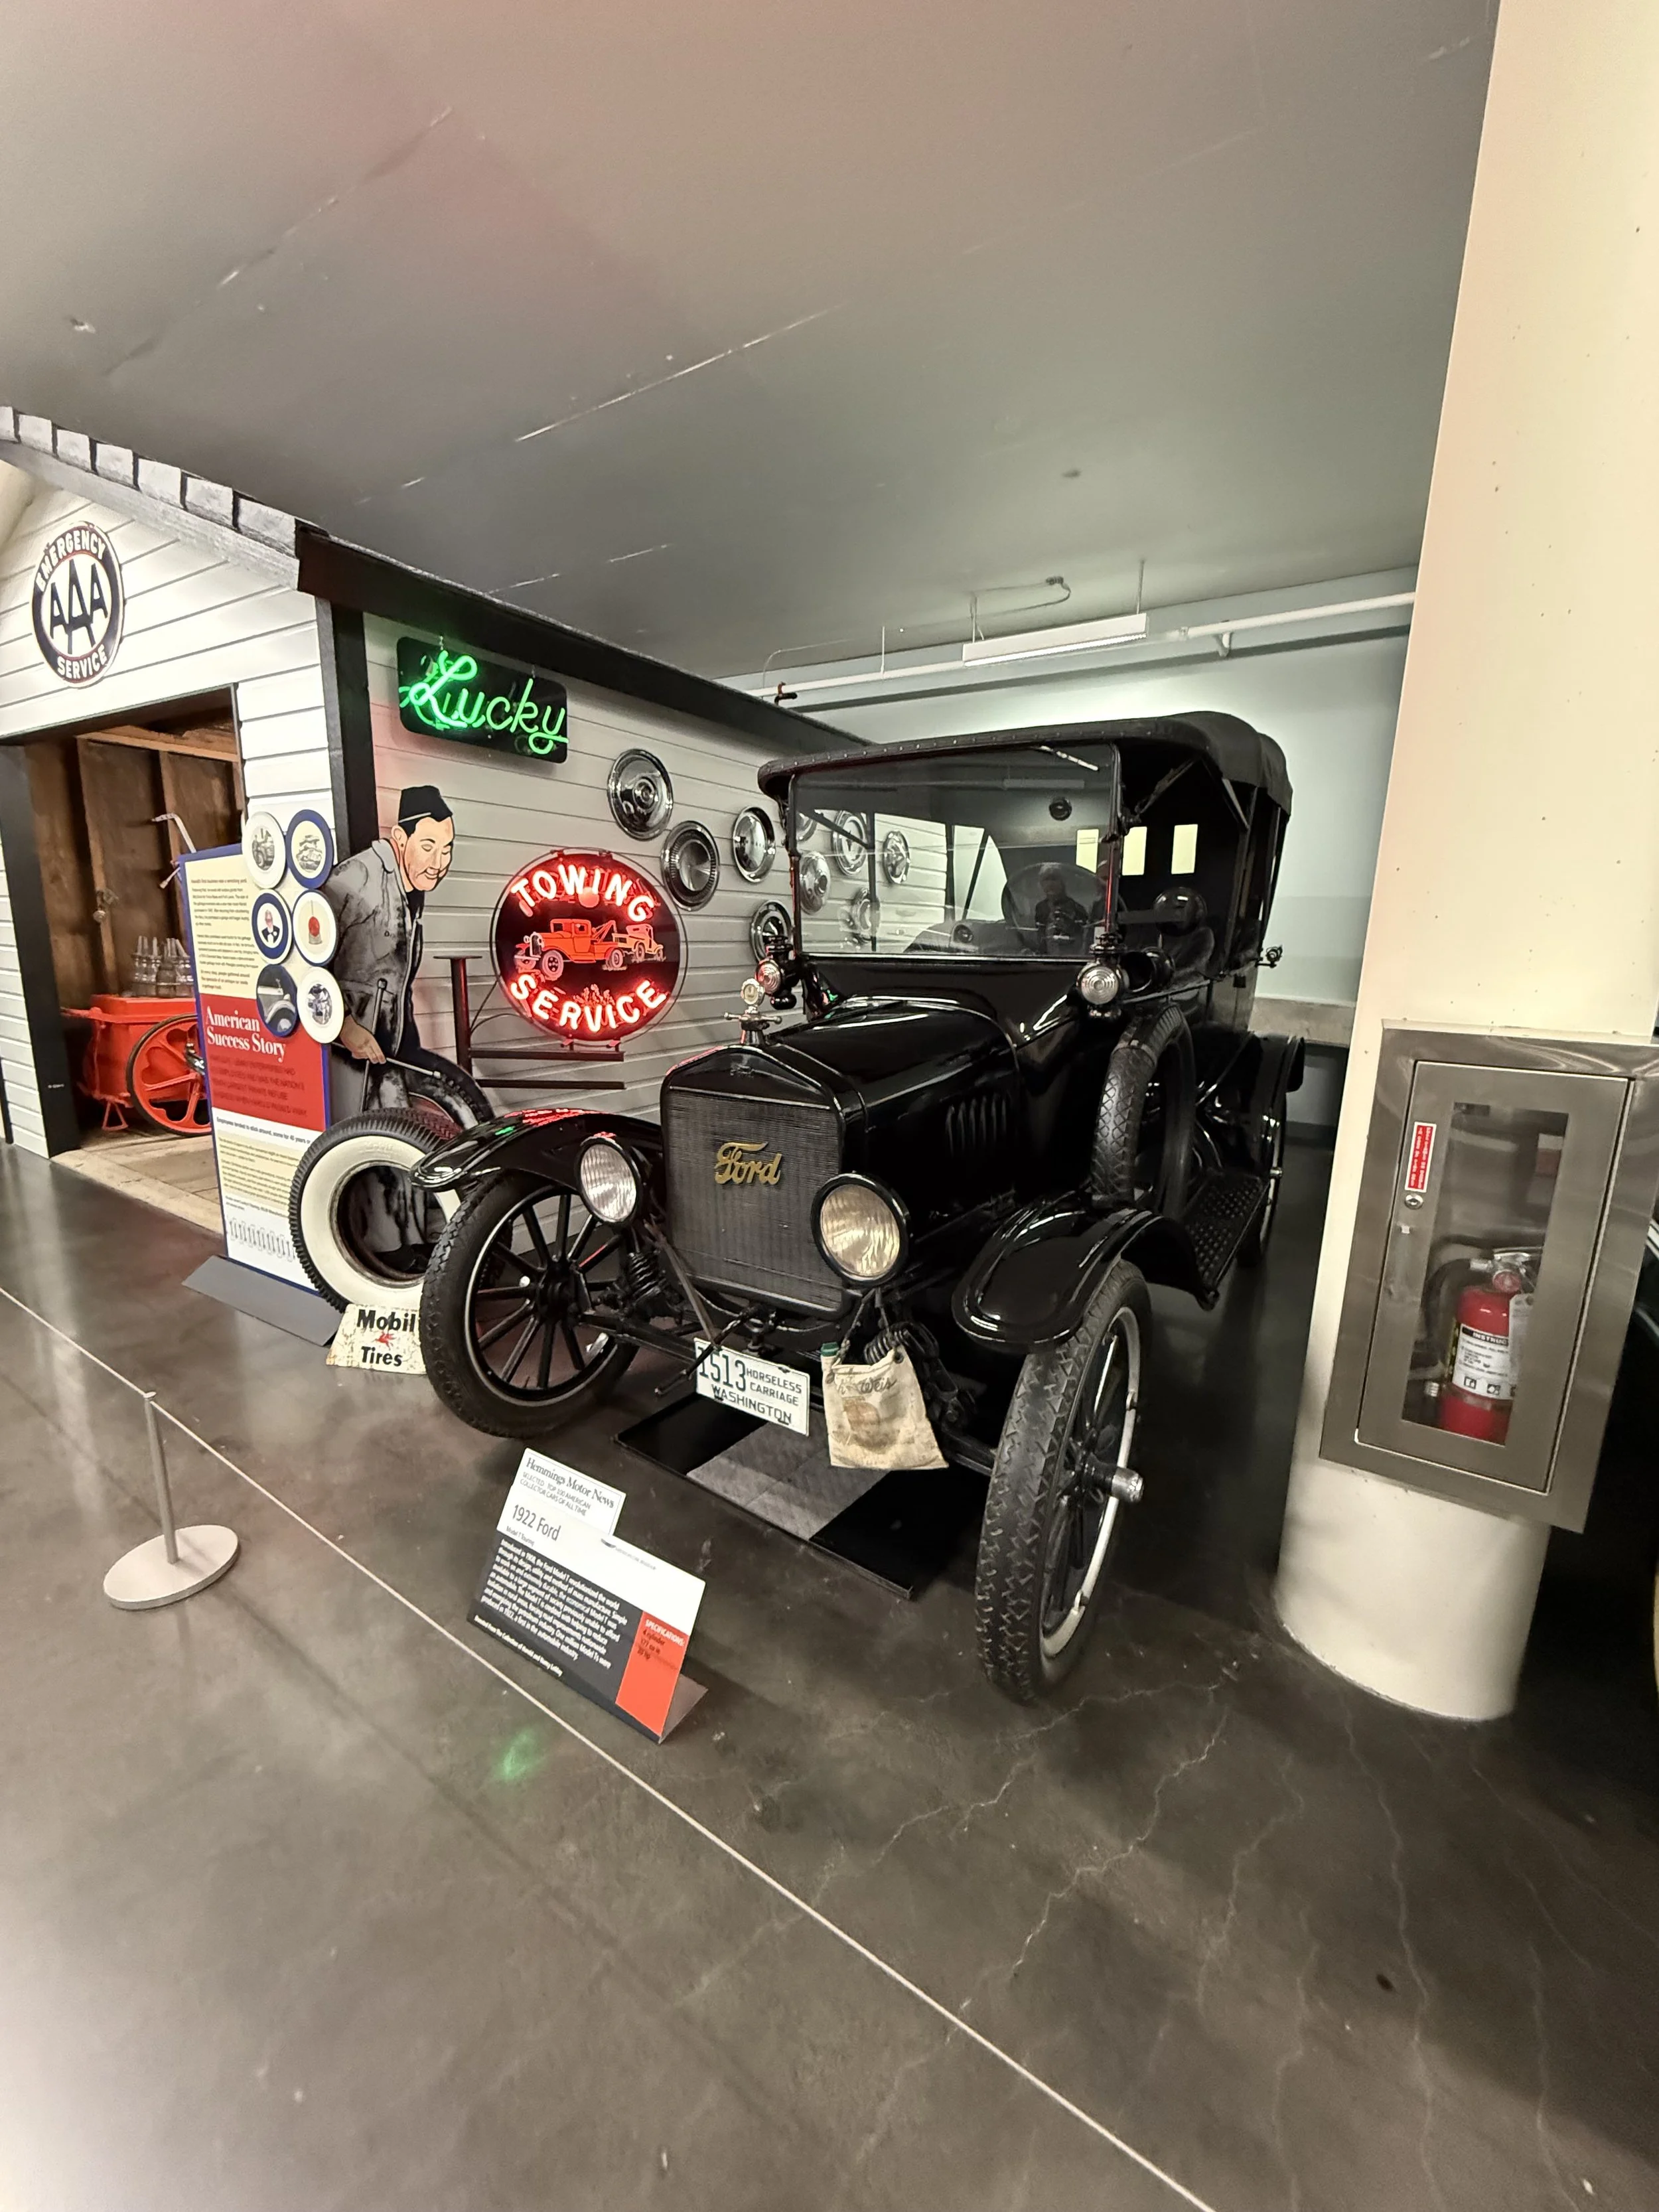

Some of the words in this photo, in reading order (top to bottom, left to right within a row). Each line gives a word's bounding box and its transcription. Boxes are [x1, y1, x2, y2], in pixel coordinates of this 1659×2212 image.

[35, 530, 106, 592] EMERGENCY
[50, 558, 108, 654] AAA
[57, 644, 107, 680] SERVICE
[399, 650, 569, 755] Lucky
[511, 864, 654, 922] TOWING
[206, 1005, 260, 1032] American
[510, 974, 667, 1033] SERVICE
[207, 1027, 250, 1051] Success
[252, 1033, 286, 1063] Story
[714, 1142, 782, 1185] Ford
[356, 1309, 416, 1332] Mobil
[361, 1346, 403, 1366] Tires
[747, 1367, 802, 1394] HORSELESS
[750, 1382, 799, 1406] CARRIAGE
[711, 1384, 792, 1424] WASHINGTON
[520, 1479, 546, 1496] COLLECTOR
[546, 1491, 558, 1502] CARS
[526, 1457, 566, 1485] Hemmings
[566, 1477, 591, 1497] Motor
[591, 1489, 614, 1509] News
[565, 1493, 591, 1509] AMERICAN
[506, 1526, 518, 1536] Model
[512, 1504, 536, 1528] 1922
[536, 1517, 561, 1541] Ford
